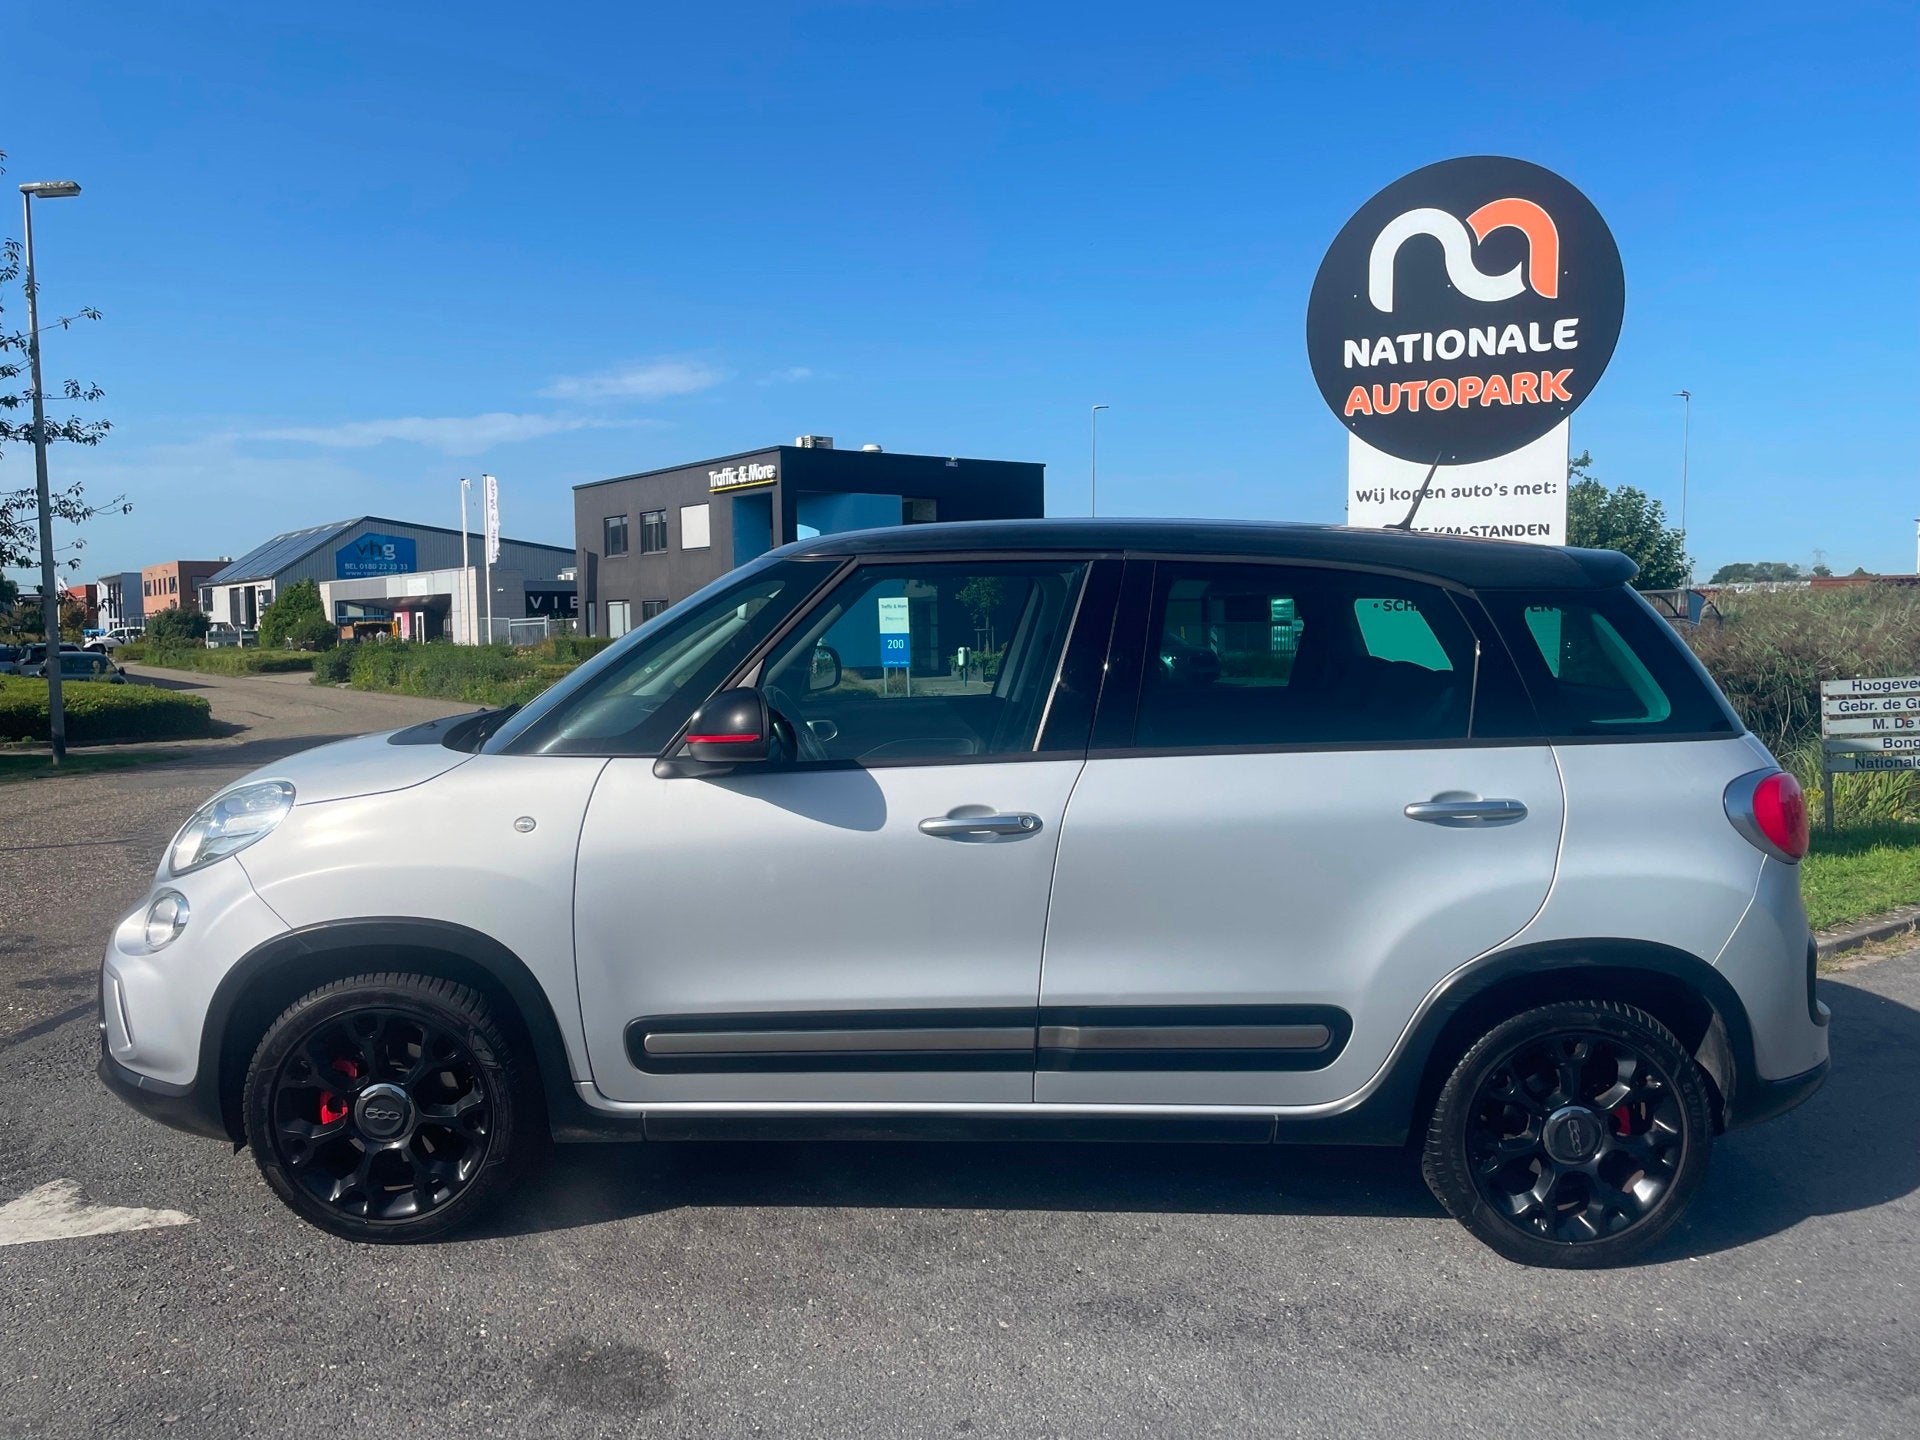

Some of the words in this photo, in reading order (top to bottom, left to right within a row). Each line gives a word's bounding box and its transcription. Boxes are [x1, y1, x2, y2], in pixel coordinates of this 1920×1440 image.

[1344, 318, 1579, 368] NATIONALE
[1344, 368, 1574, 416] AUTOPARK
[708, 467, 738, 487] Traffic
[748, 463, 776, 481] More
[1356, 488, 1385, 504] Wij
[1390, 487, 1446, 502] kopen
[1513, 481, 1557, 496] met:
[355, 540, 396, 560] vhg
[887, 640, 904, 649] 200
[1852, 680, 1920, 692] Hoogeve
[1839, 701, 1877, 712] Gebr.
[1883, 699, 1901, 710] de
[1872, 719, 1889, 730] M.
[1895, 717, 1915, 729] De
[365, 1108, 401, 1120] 500
